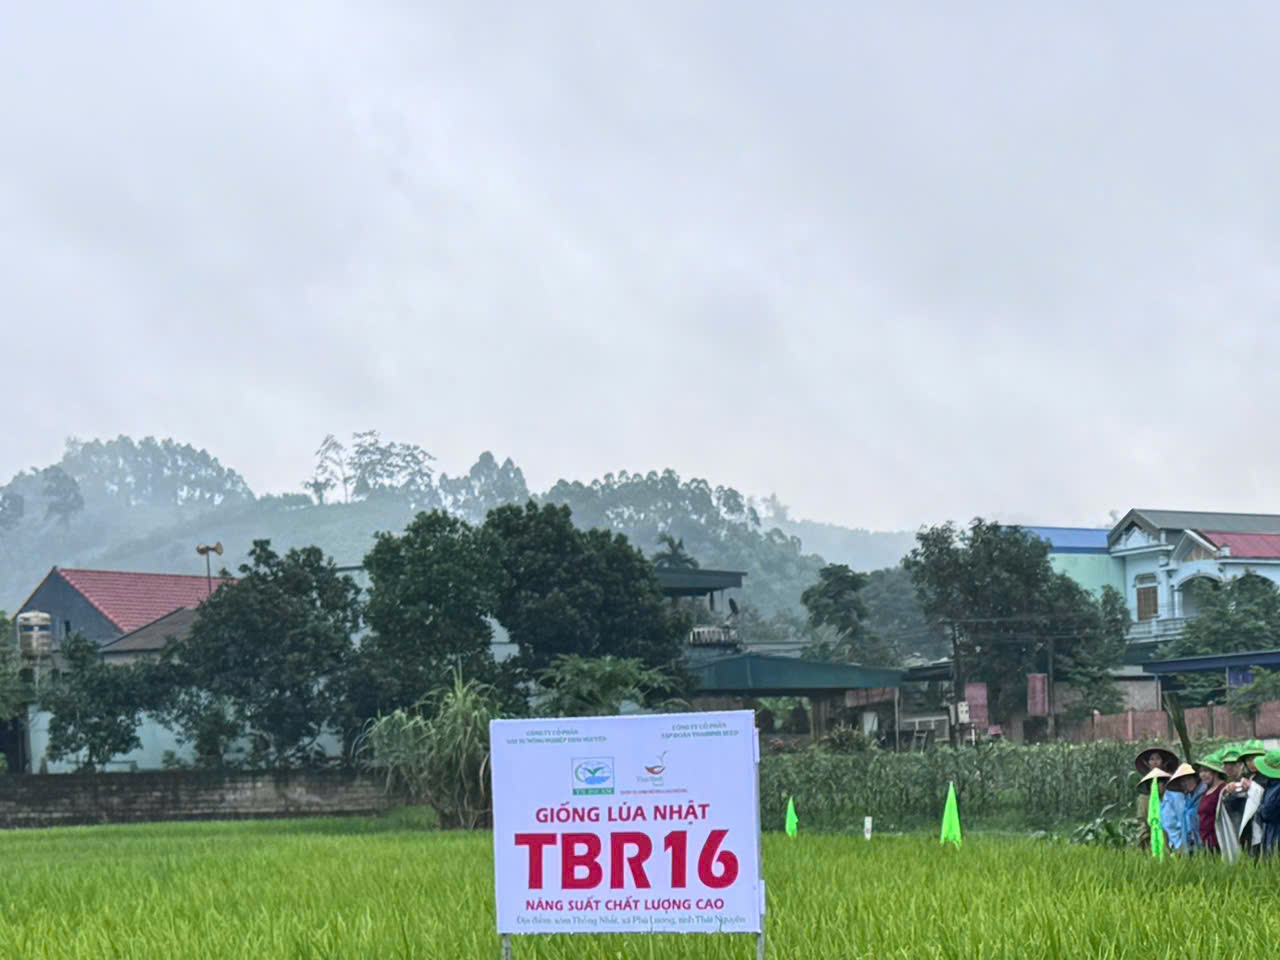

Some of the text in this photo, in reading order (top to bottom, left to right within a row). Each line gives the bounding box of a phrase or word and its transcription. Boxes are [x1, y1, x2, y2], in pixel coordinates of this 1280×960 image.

[536, 799, 710, 825] GIỐNG LÚA NHẬT
[514, 829, 739, 890] TBR16
[568, 896, 601, 911] SUẤT
[605, 895, 640, 911] CHẤT
[644, 897, 691, 914] LƯỢNG
[696, 897, 724, 910] CAO
